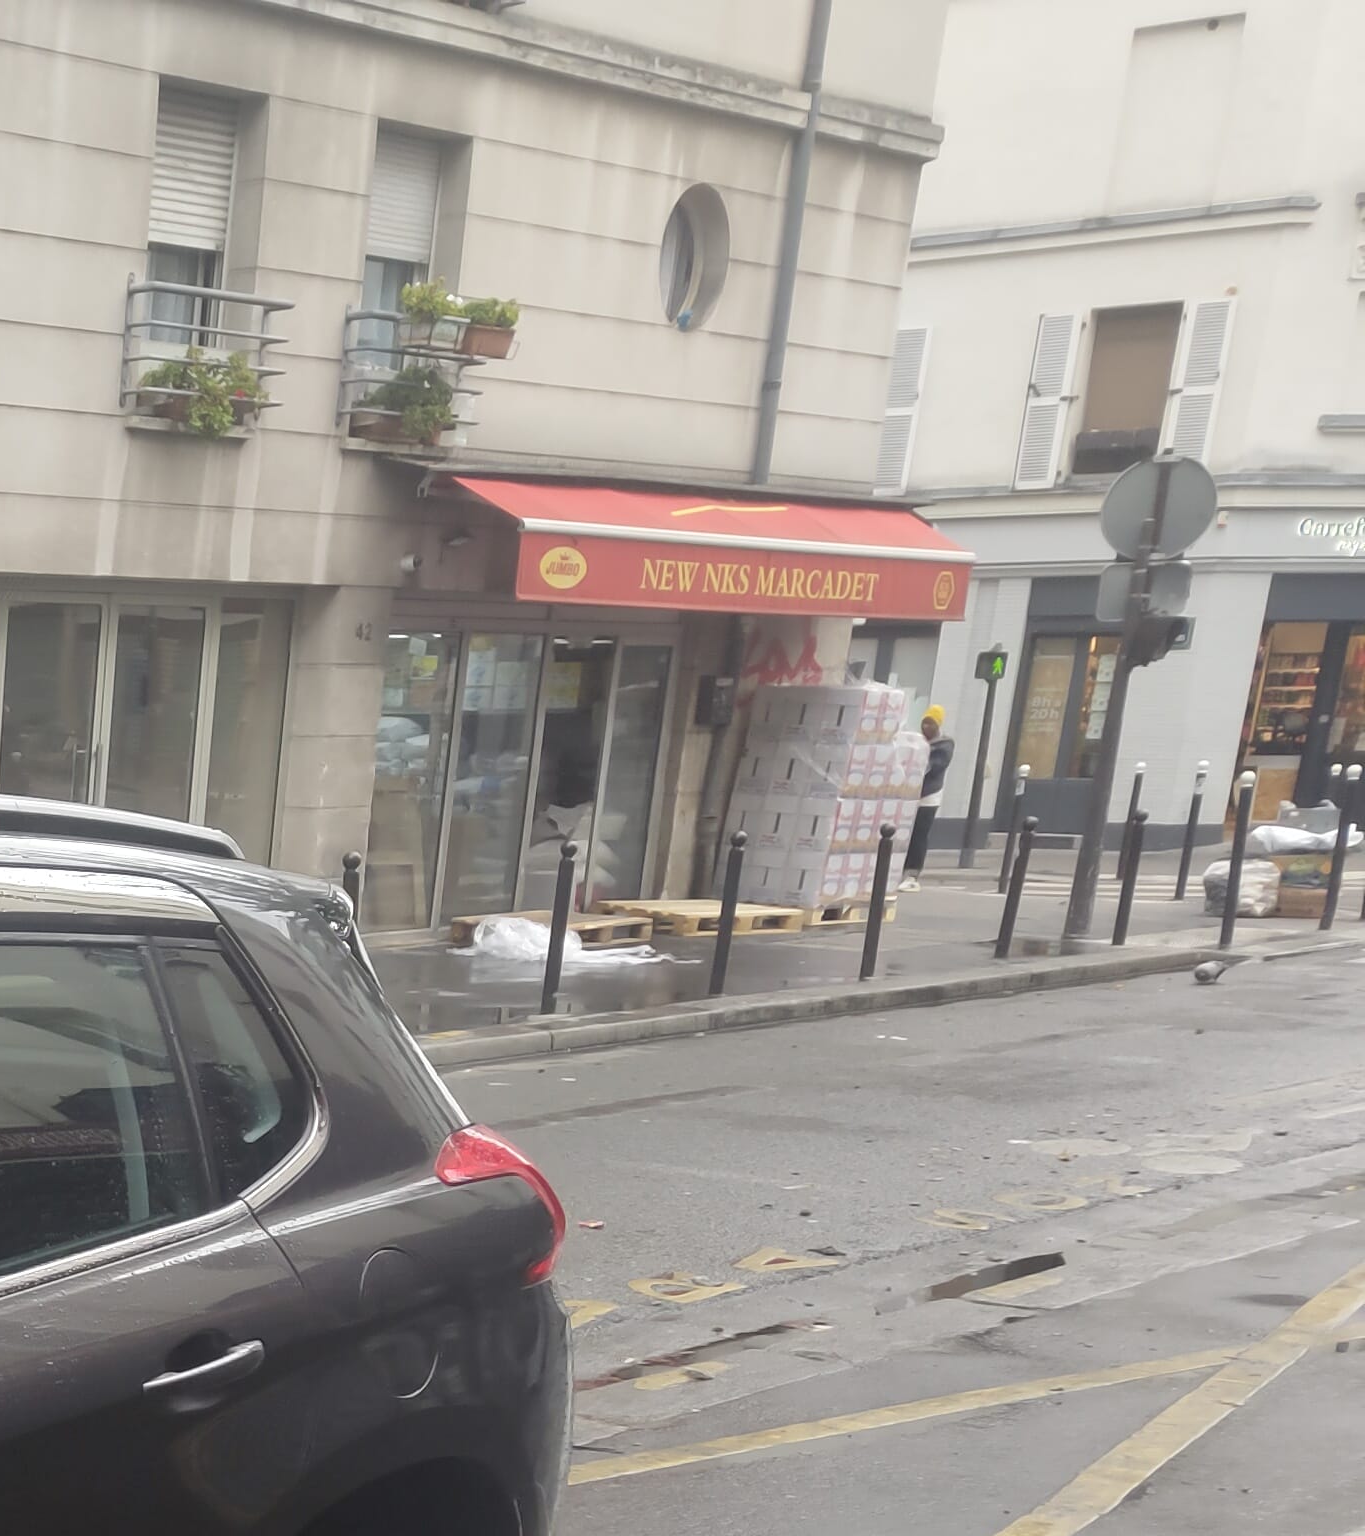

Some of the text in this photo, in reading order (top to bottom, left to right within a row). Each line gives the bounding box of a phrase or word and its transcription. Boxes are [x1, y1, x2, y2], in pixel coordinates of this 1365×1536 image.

[1297, 516, 1365, 537] Carref
[545, 561, 580, 577] JUMBO
[639, 558, 879, 601] NEW NKS MARCADET
